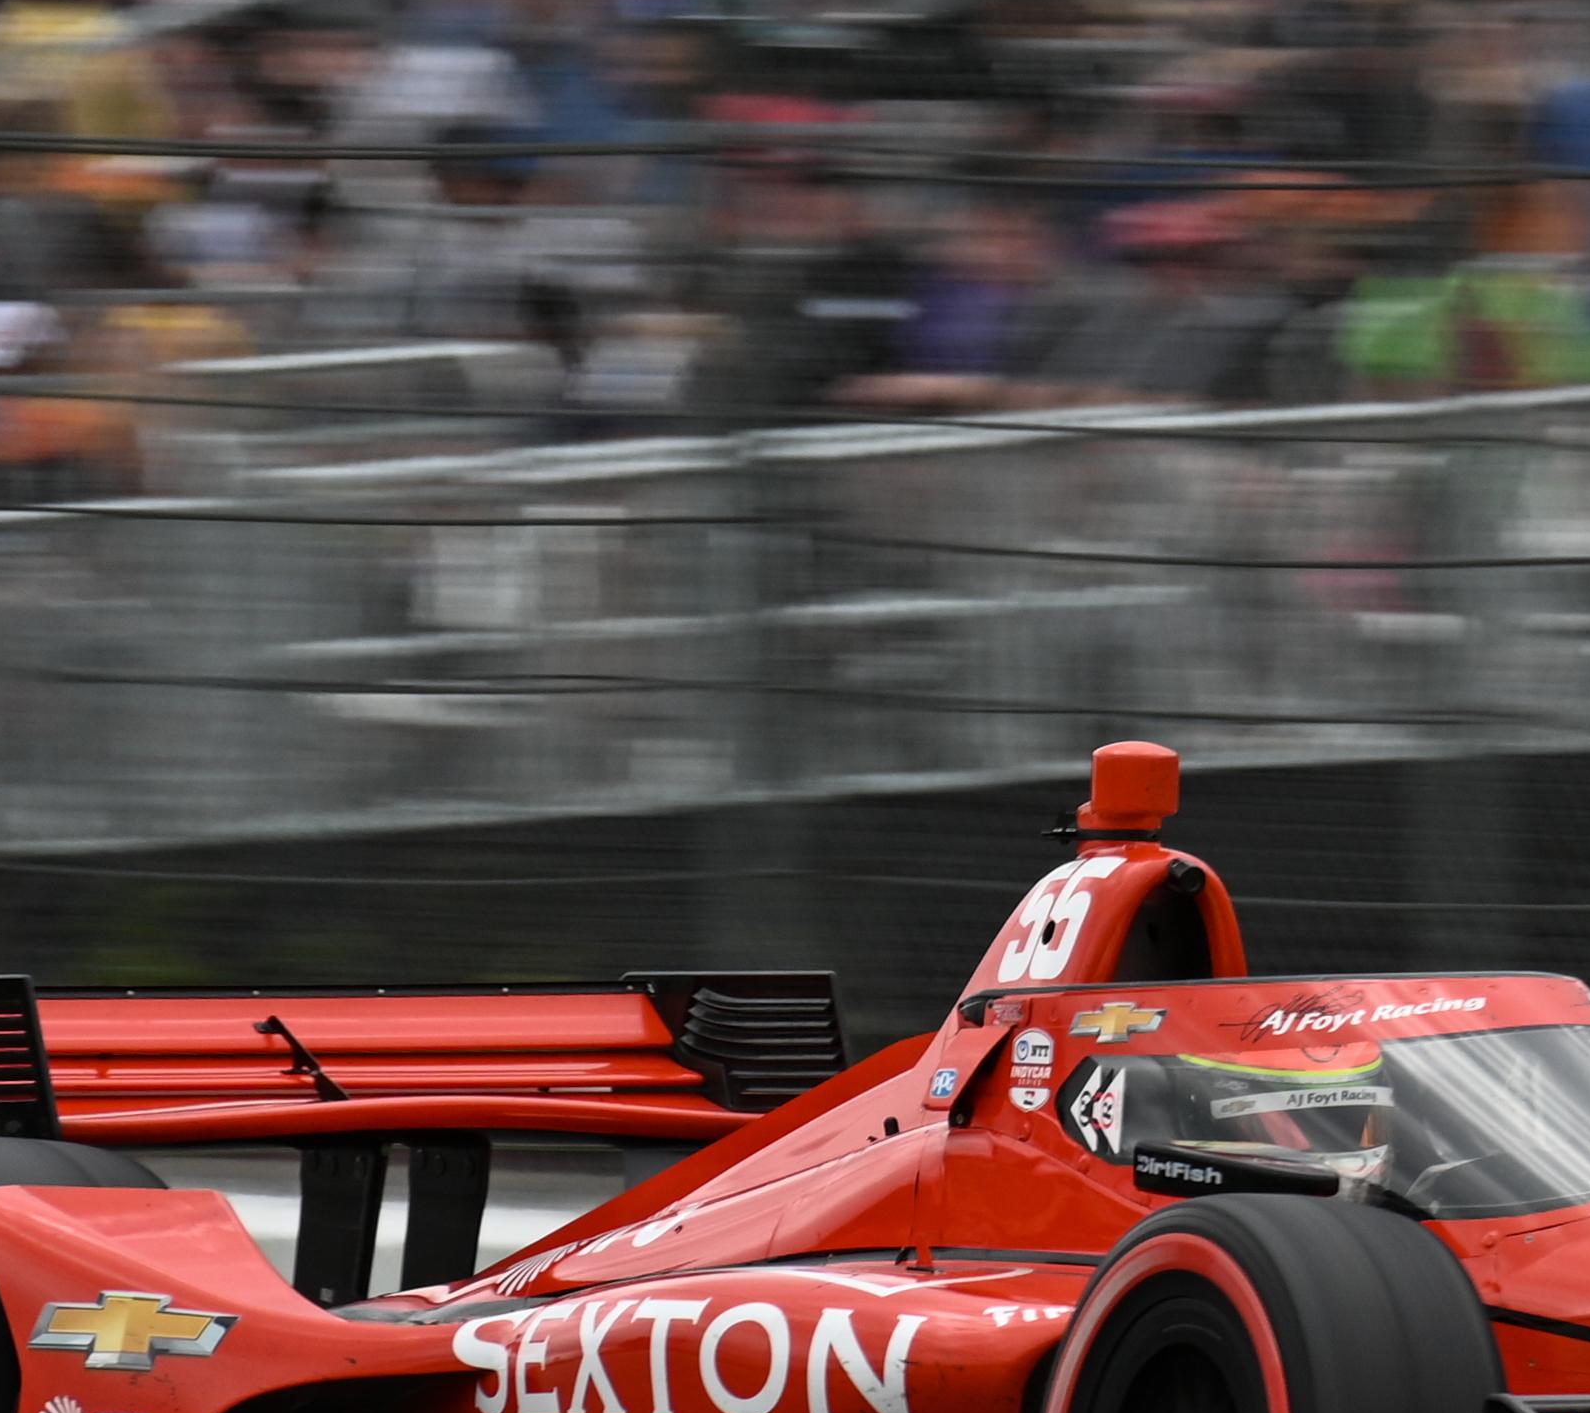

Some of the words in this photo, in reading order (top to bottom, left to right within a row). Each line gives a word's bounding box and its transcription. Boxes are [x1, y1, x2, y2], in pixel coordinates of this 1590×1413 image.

[997, 856, 1128, 983] 55
[1260, 1009, 1294, 1035] AJ
[1296, 1009, 1364, 1033] Foyt
[1371, 996, 1487, 1023] Racing
[1010, 1065, 1053, 1079] INDYCAR
[1286, 1093, 1304, 1107] AJ
[1306, 1091, 1338, 1105] Foyt
[1340, 1089, 1377, 1103] Racing
[1135, 1154, 1223, 1185] DirtFish
